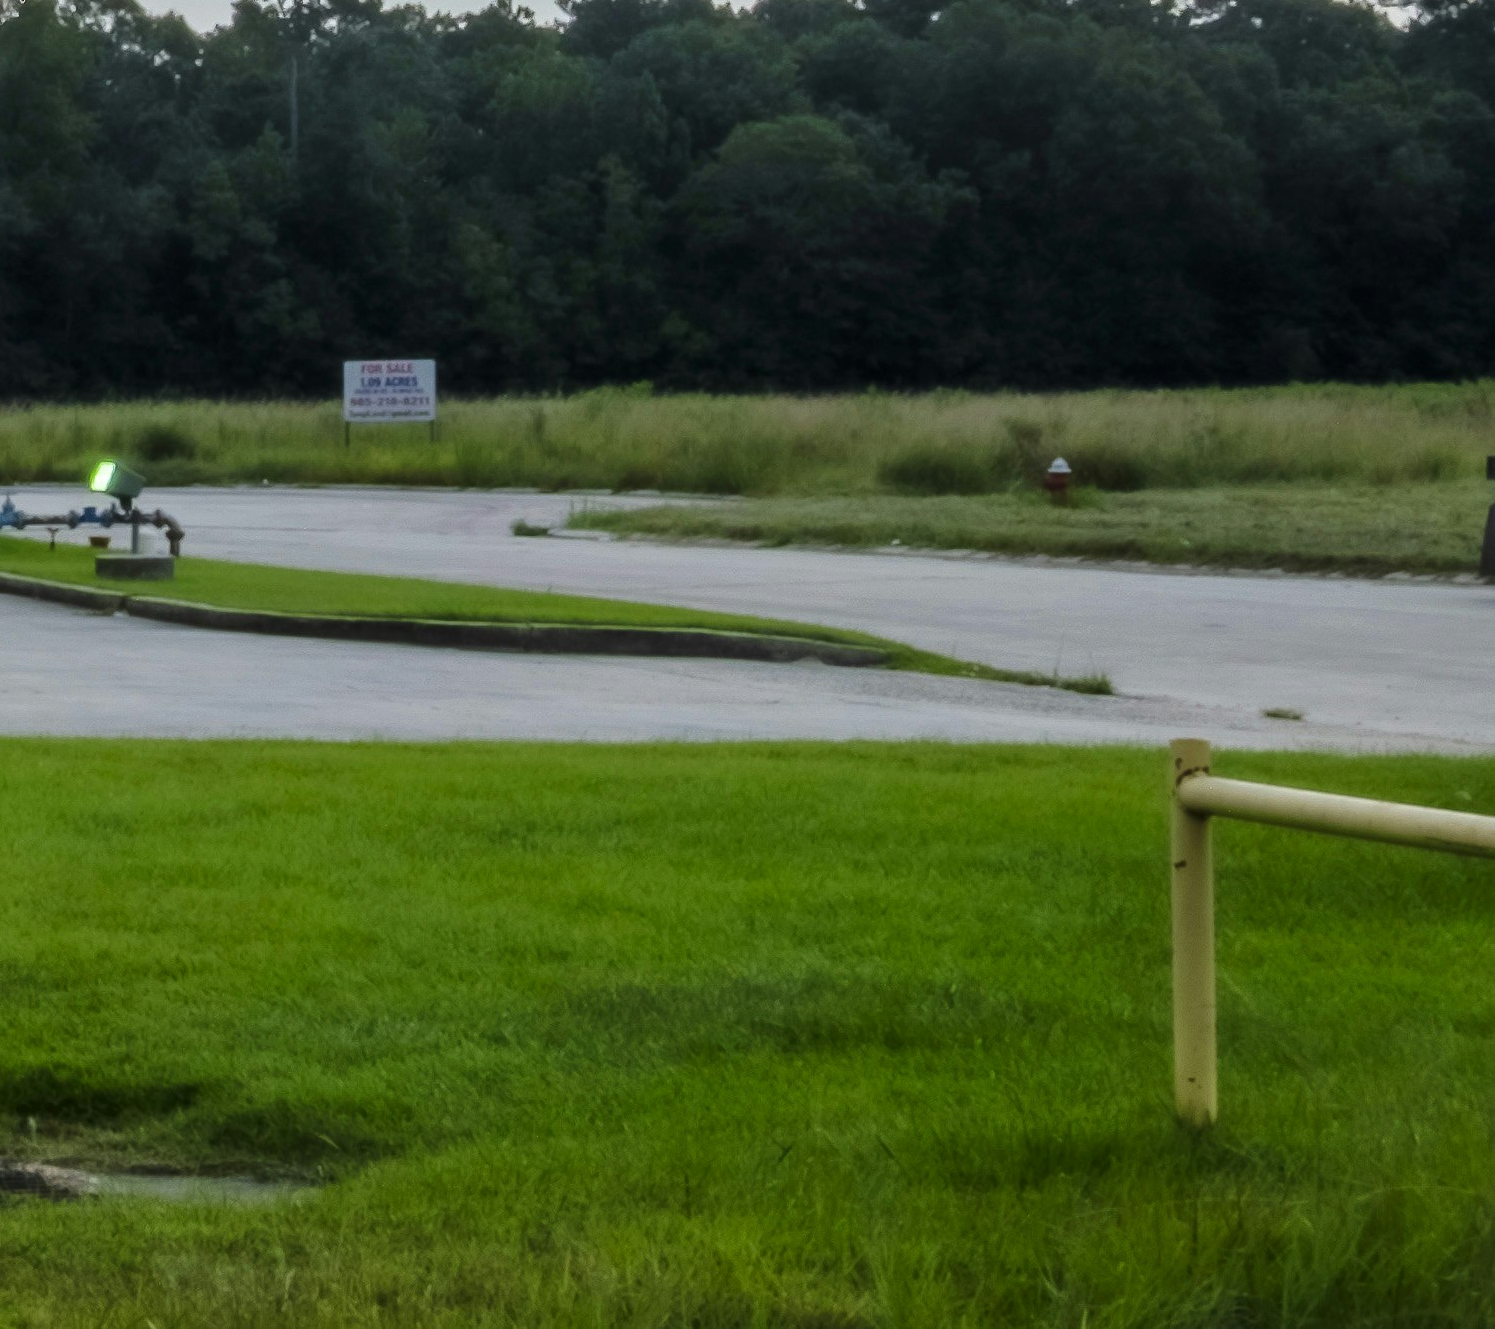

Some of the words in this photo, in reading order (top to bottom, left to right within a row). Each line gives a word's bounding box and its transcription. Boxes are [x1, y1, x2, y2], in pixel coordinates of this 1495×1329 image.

[361, 363, 382, 374] FOR
[386, 362, 413, 373] SALE
[385, 376, 418, 387] ACRES
